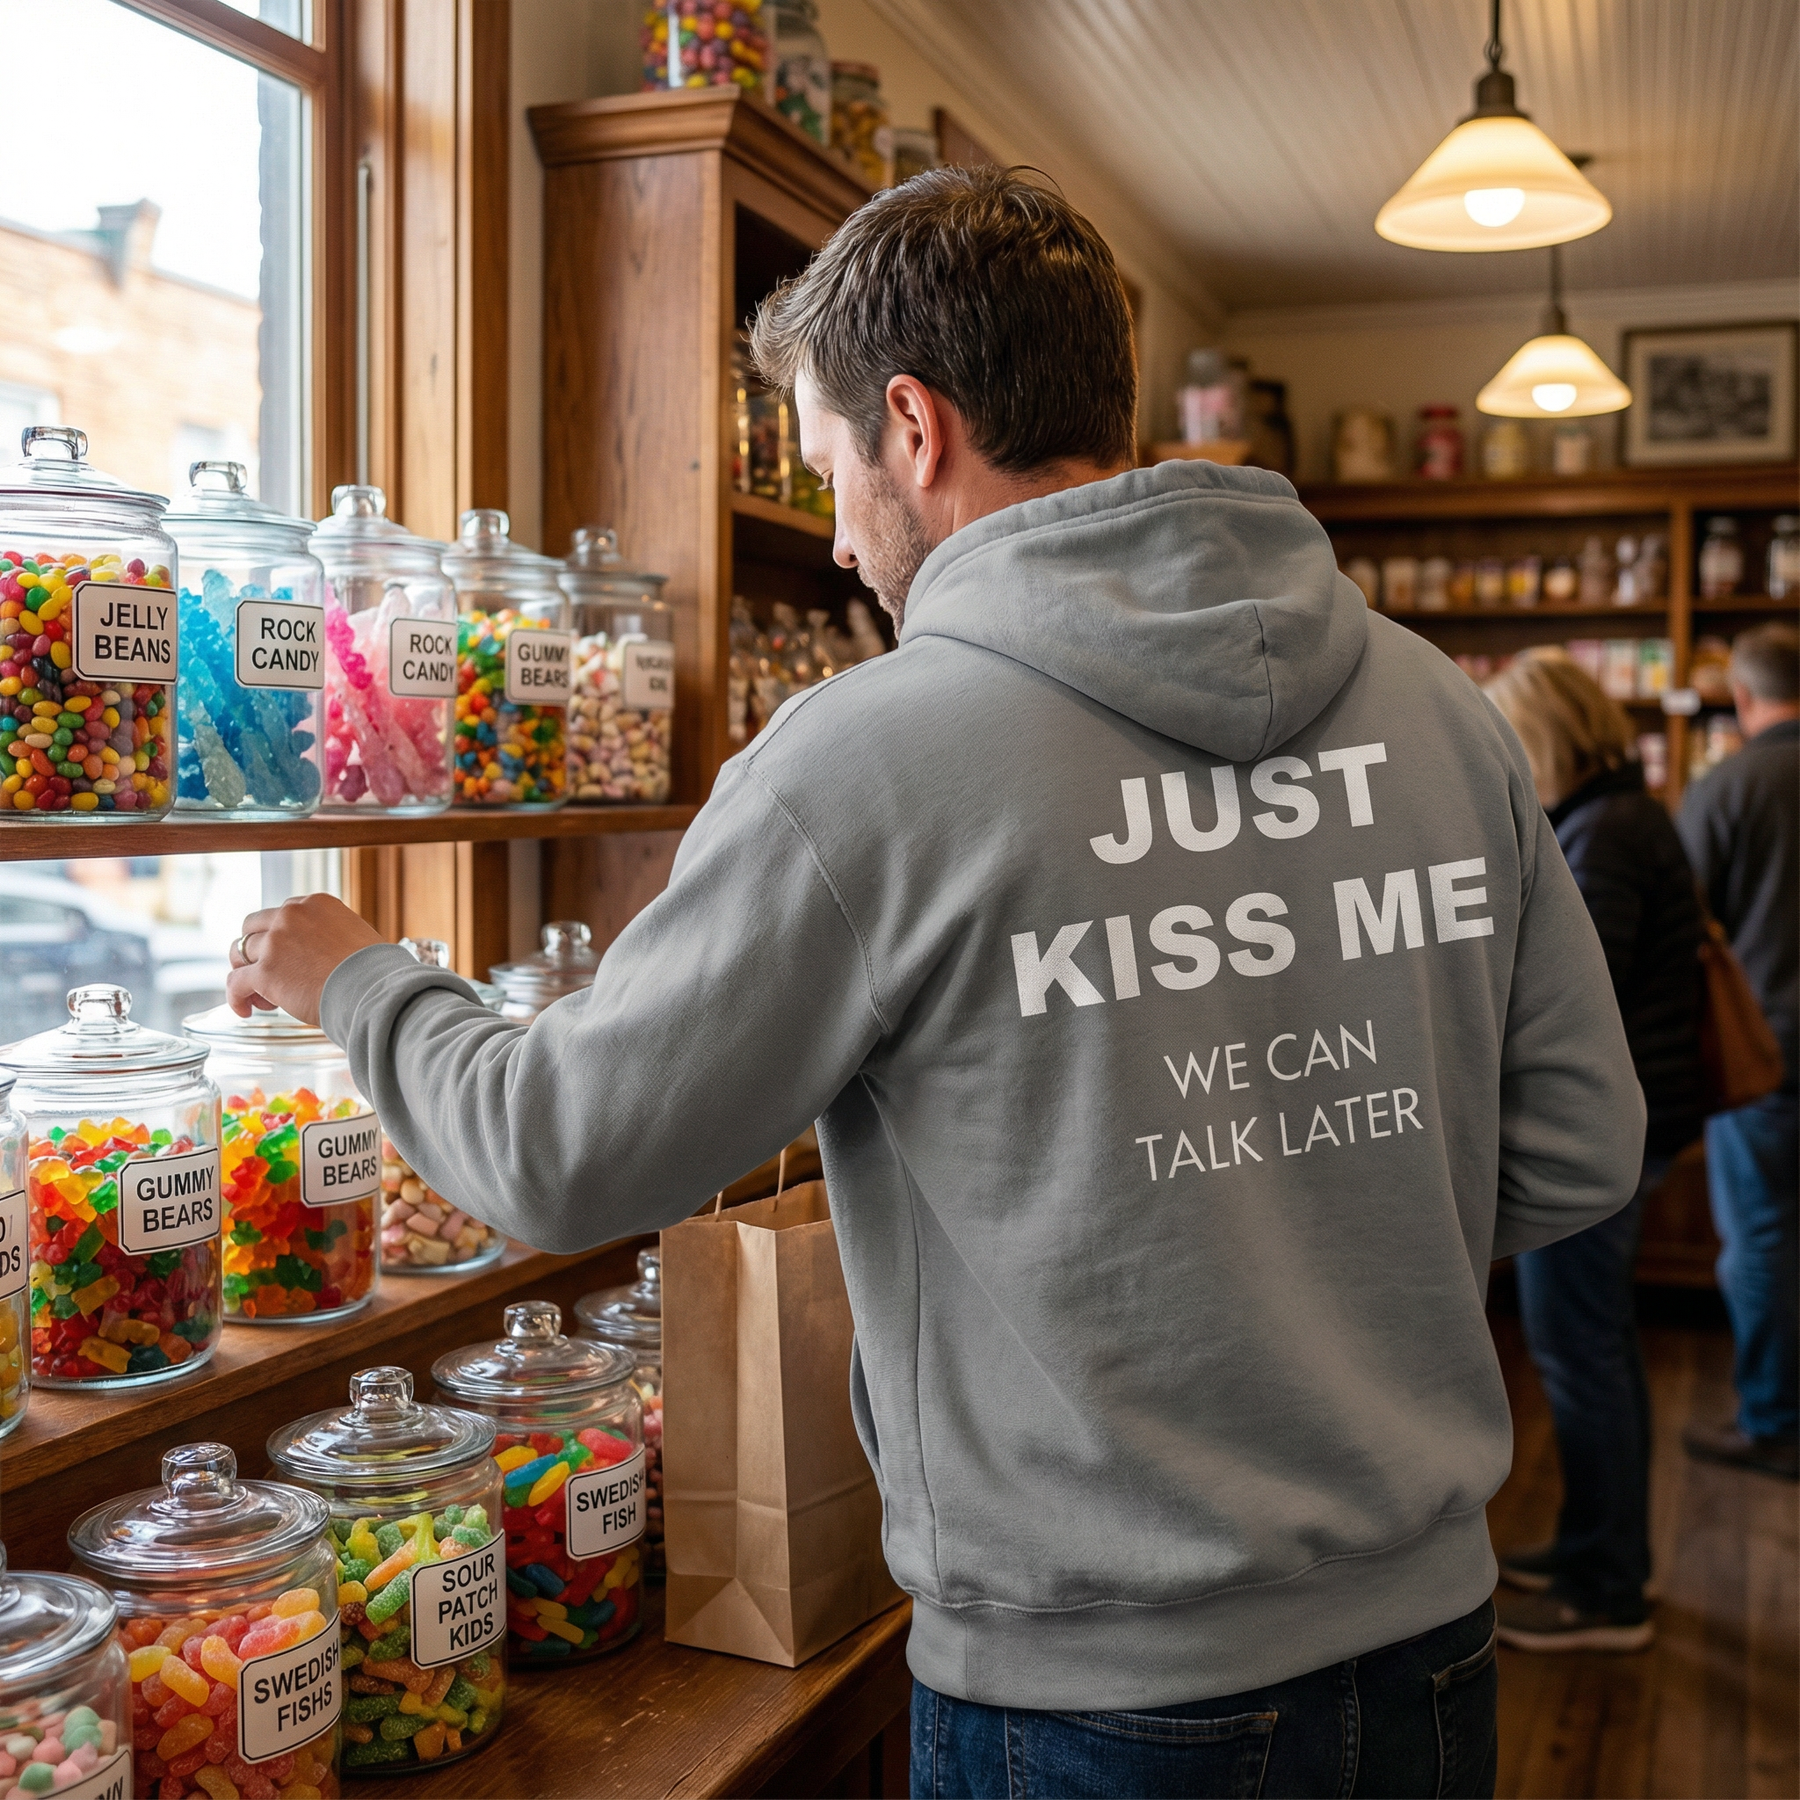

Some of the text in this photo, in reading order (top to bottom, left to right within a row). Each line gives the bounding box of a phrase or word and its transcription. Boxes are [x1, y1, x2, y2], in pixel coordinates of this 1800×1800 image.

[100, 602, 168, 631] JELLY
[261, 617, 316, 643] ROCK
[94, 634, 171, 664] BEANS
[251, 646, 319, 672] CANDY
[410, 633, 452, 656] ROCK
[403, 659, 455, 682] CANDY
[1089, 742, 1387, 864] JUST
[1010, 856, 1495, 1017] KISS ME
[1163, 1019, 1377, 1099] WE CAN
[317, 1127, 378, 1159] GUMMY
[1135, 1087, 1424, 1181] TALK LATER
[136, 1165, 214, 1202] GUMMY
[323, 1155, 377, 1187] BEARS
[143, 1197, 213, 1233] BEARS
[602, 1501, 636, 1535] FISH
[442, 1553, 495, 1592] SOUR
[438, 1578, 498, 1625] PATCH
[449, 1612, 494, 1651] KIDS
[254, 1638, 339, 1704] SWEDISH
[277, 1680, 333, 1732] FISHS
